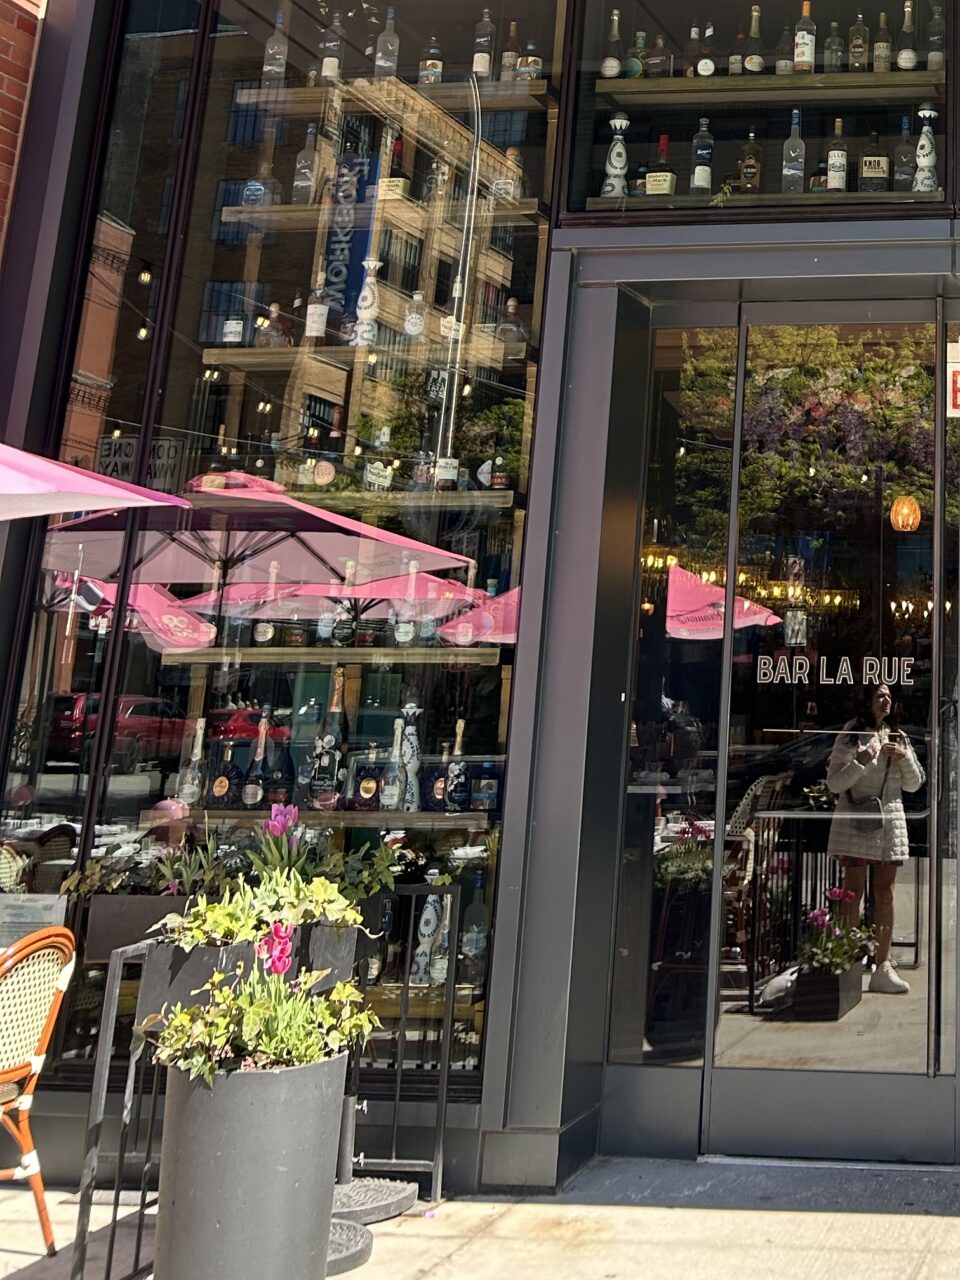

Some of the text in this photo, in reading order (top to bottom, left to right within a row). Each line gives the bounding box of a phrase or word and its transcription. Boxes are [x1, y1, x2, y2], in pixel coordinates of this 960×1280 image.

[756, 656, 915, 685] BAR LA RUE
